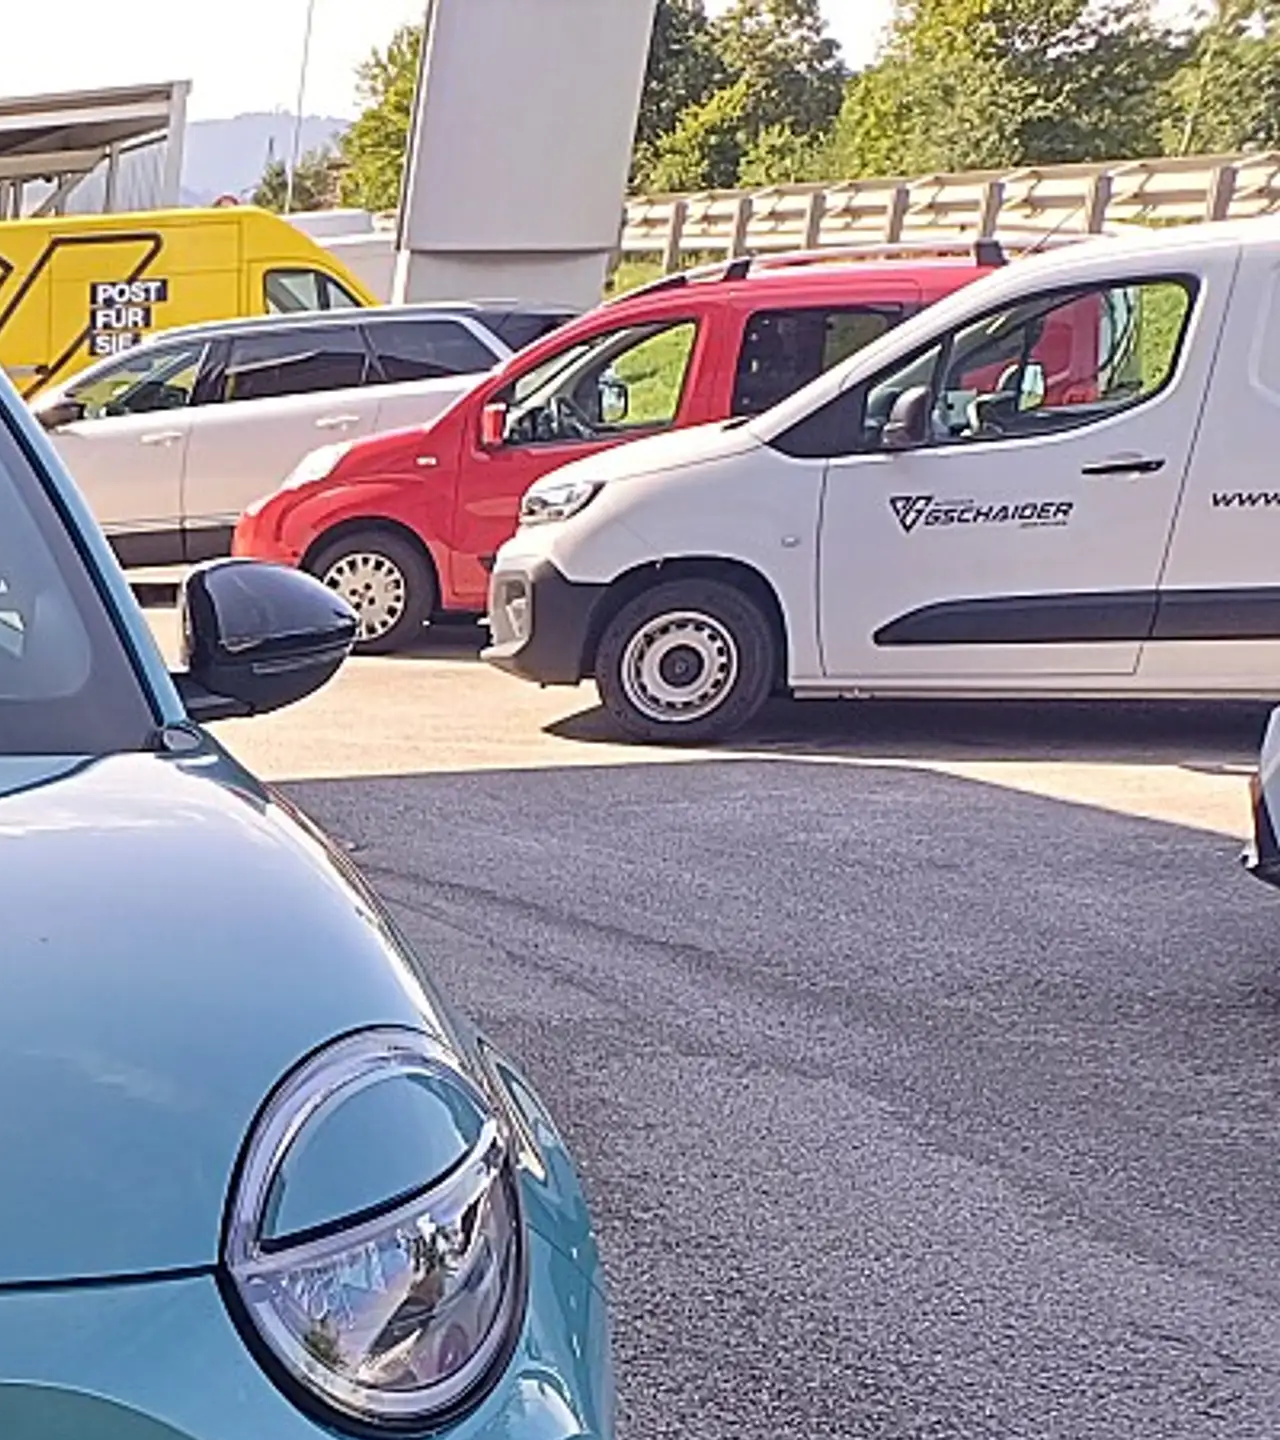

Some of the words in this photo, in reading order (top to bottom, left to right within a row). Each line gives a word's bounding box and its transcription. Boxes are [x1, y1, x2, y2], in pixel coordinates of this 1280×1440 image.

[96, 281, 161, 304] POST
[95, 304, 145, 328] FÜR
[924, 501, 1074, 527] GSCHAIDER
